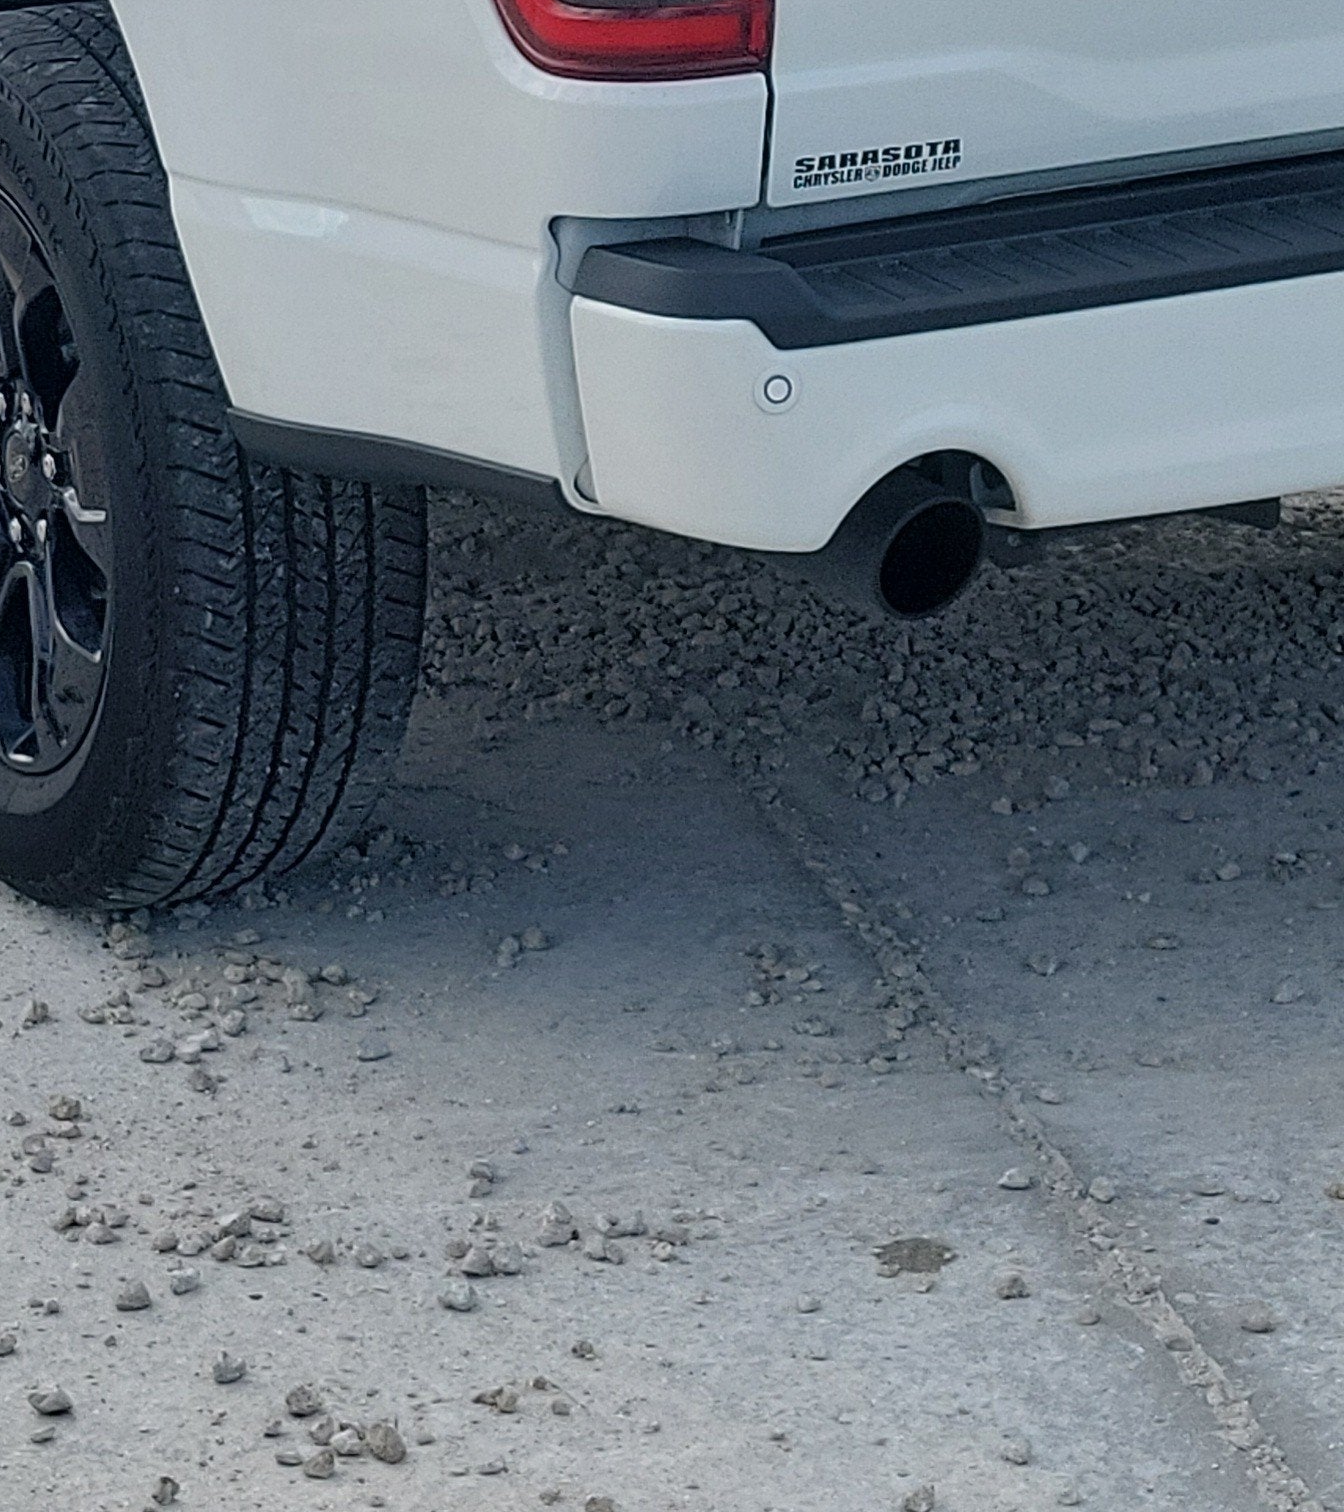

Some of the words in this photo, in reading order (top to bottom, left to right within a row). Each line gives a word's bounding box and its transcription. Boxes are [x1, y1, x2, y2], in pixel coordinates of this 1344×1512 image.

[793, 167, 863, 189] CHRYSLER
[882, 158, 928, 178] DODGE
[931, 155, 961, 172] JEEP
[794, 138, 961, 174] SARASOTA
